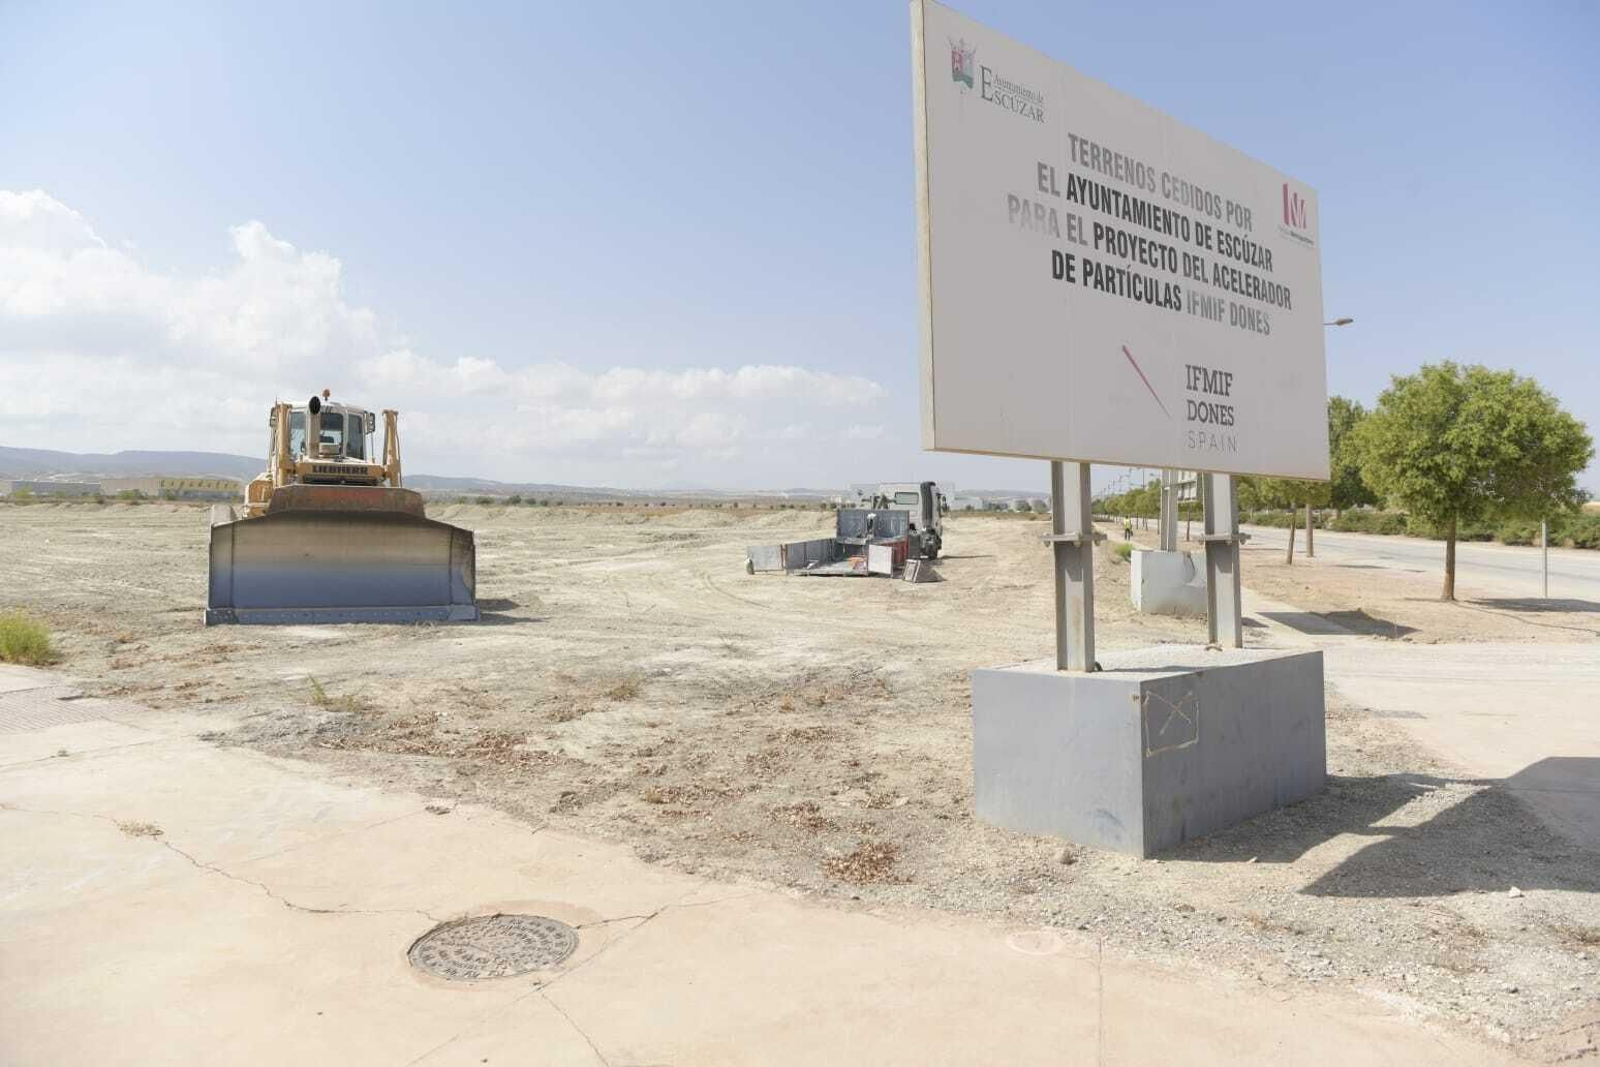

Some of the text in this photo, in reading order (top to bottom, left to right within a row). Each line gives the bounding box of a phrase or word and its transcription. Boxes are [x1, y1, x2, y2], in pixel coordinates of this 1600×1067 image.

[1037, 161, 1060, 197] EL
[1066, 172, 1190, 242] AYUNTAMIENTO
[1195, 221, 1212, 250] DE
[1217, 229, 1273, 272] ESCÚZAR
[1067, 132, 1252, 232] TERRENOS CEDIDOS POR
[1007, 193, 1292, 310] PARA EL PROYECTO DEL ACELERADOR
[1051, 249, 1270, 336] DE PARTÍCULAS IFMIF DONES
[1185, 364, 1233, 397] IFMIF
[1186, 399, 1234, 426] DONES
[1188, 430, 1237, 453] SPAIN
